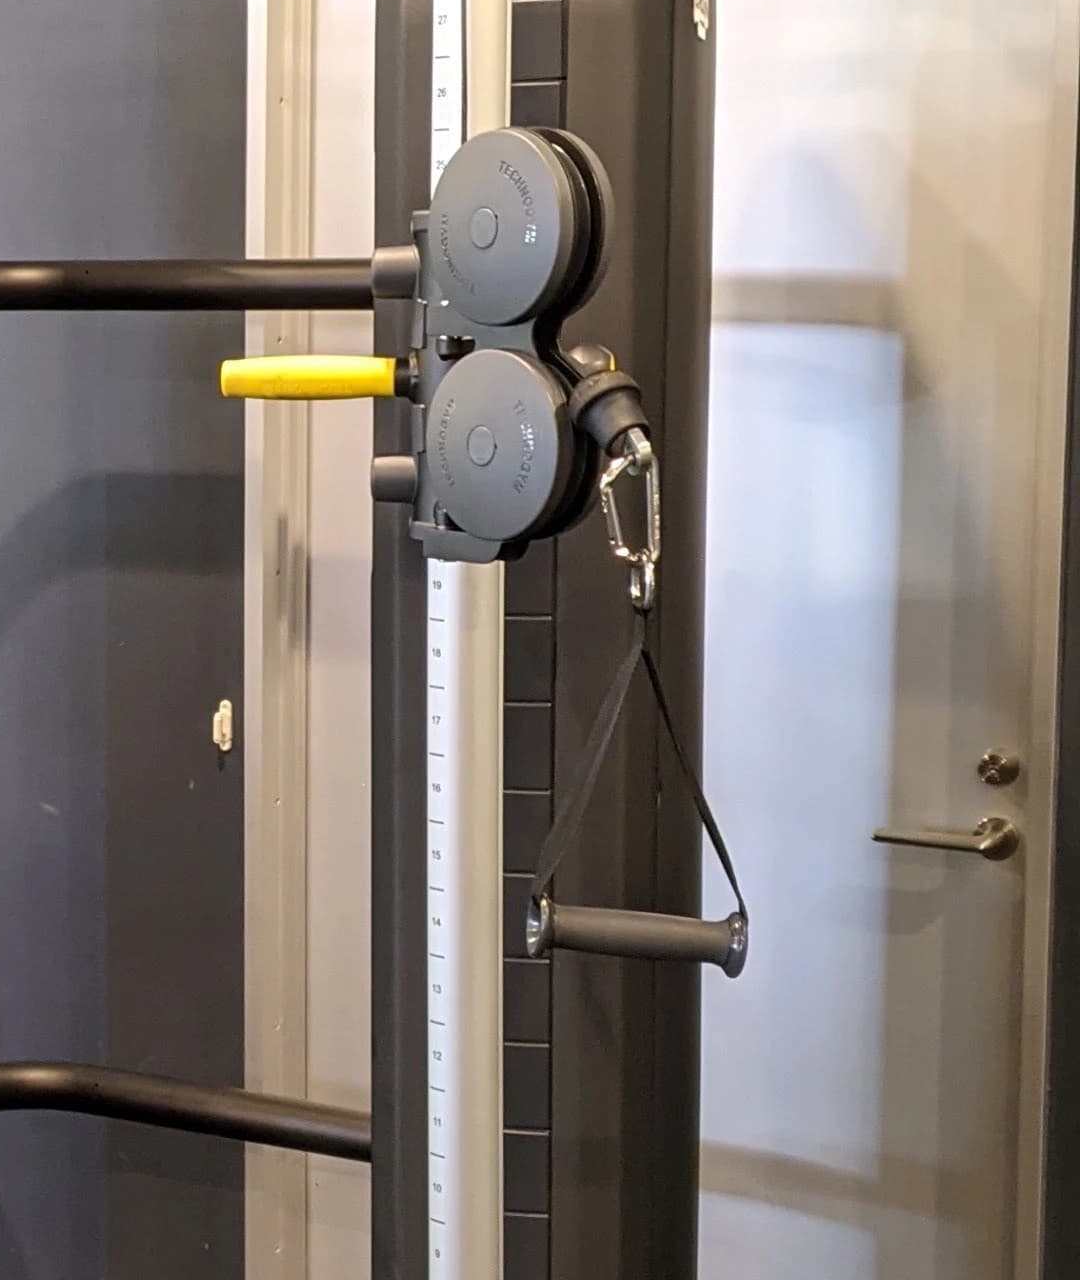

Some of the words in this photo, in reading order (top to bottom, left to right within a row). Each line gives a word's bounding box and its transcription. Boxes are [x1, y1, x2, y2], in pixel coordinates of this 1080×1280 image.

[438, 15, 447, 25] 27
[437, 88, 446, 97] 26
[436, 160, 446, 170] 25
[432, 580, 442, 590] 19
[432, 648, 441, 658] 18
[432, 715, 441, 724] 17
[432, 783, 441, 793] 16
[432, 850, 441, 860] 15
[432, 917, 441, 927] 14
[432, 984, 441, 994] 13
[432, 1051, 442, 1061] 12
[433, 1117, 441, 1128] 11
[432, 1182, 442, 1193] 10
